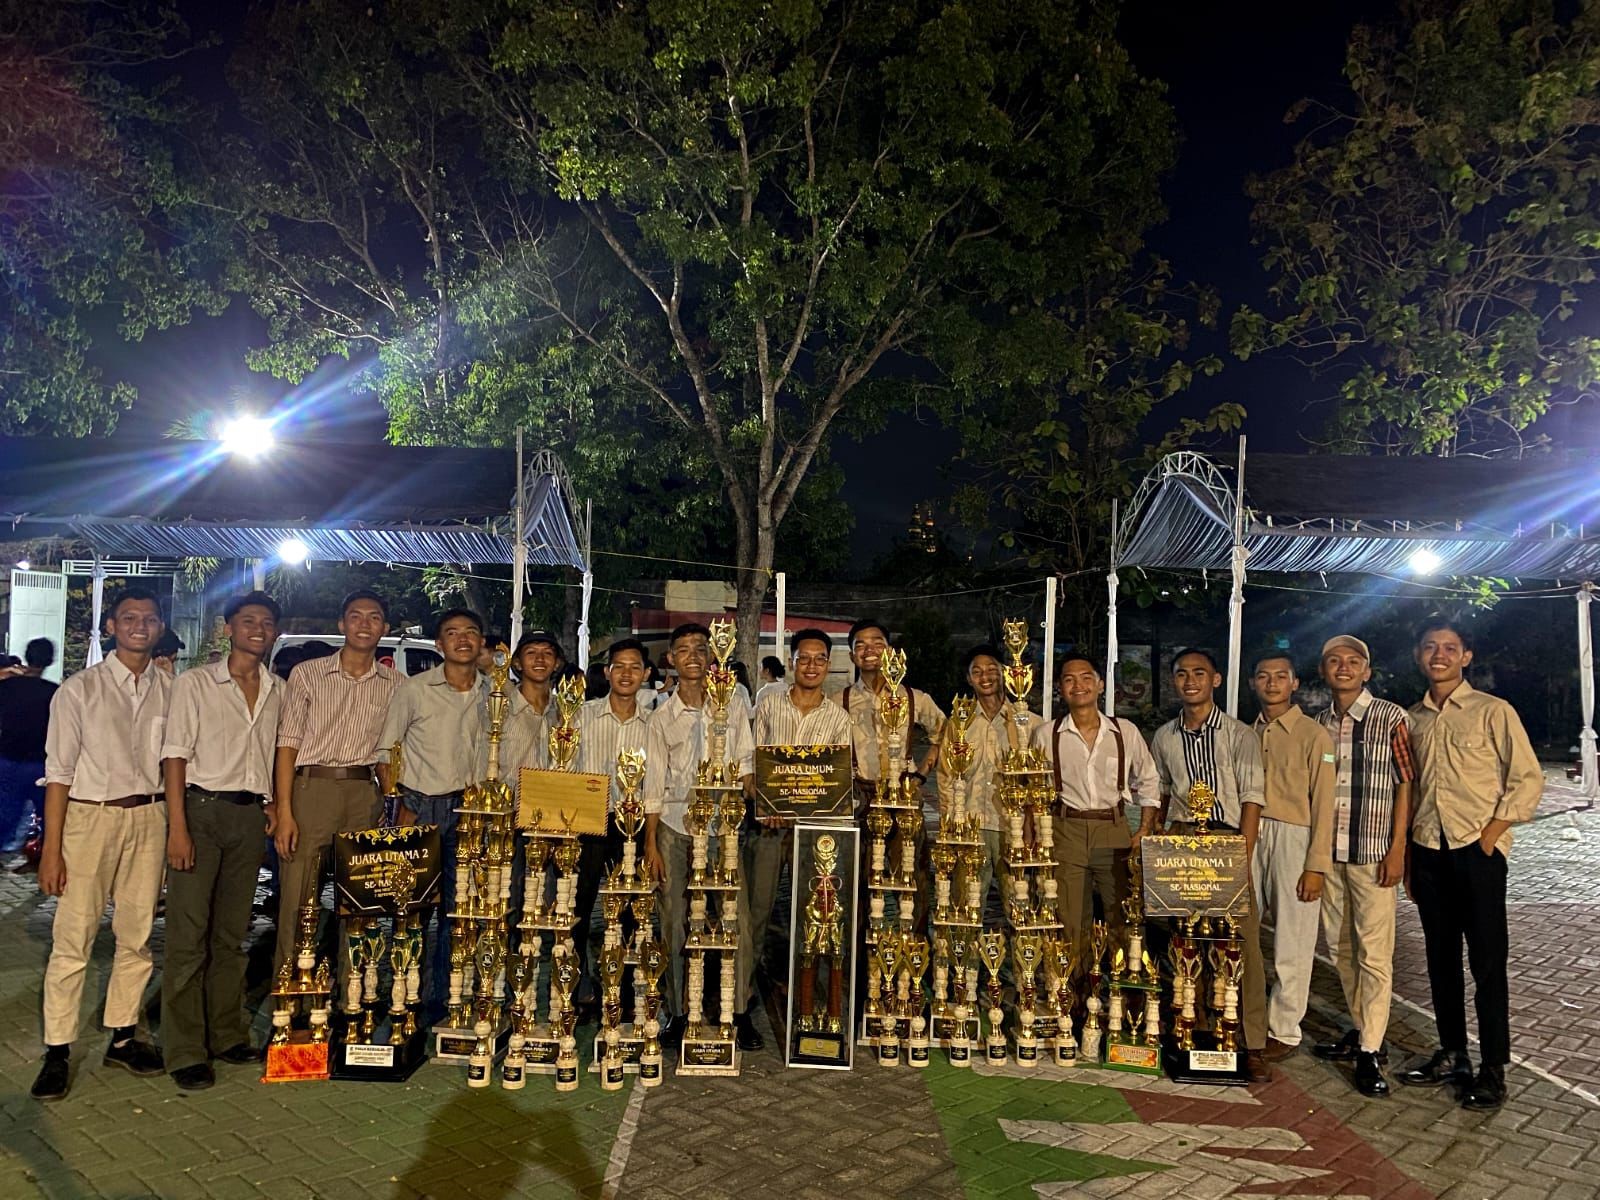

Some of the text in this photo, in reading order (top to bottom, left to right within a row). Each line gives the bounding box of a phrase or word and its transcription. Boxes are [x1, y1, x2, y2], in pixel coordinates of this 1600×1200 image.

[772, 765, 833, 774] JUARA UMUM
[348, 848, 429, 866] JUARA UTAMA 2
[1154, 858, 1188, 868] JUARA
[1189, 858, 1225, 868] UTAMA
[1183, 883, 1222, 891] NASIONAL
